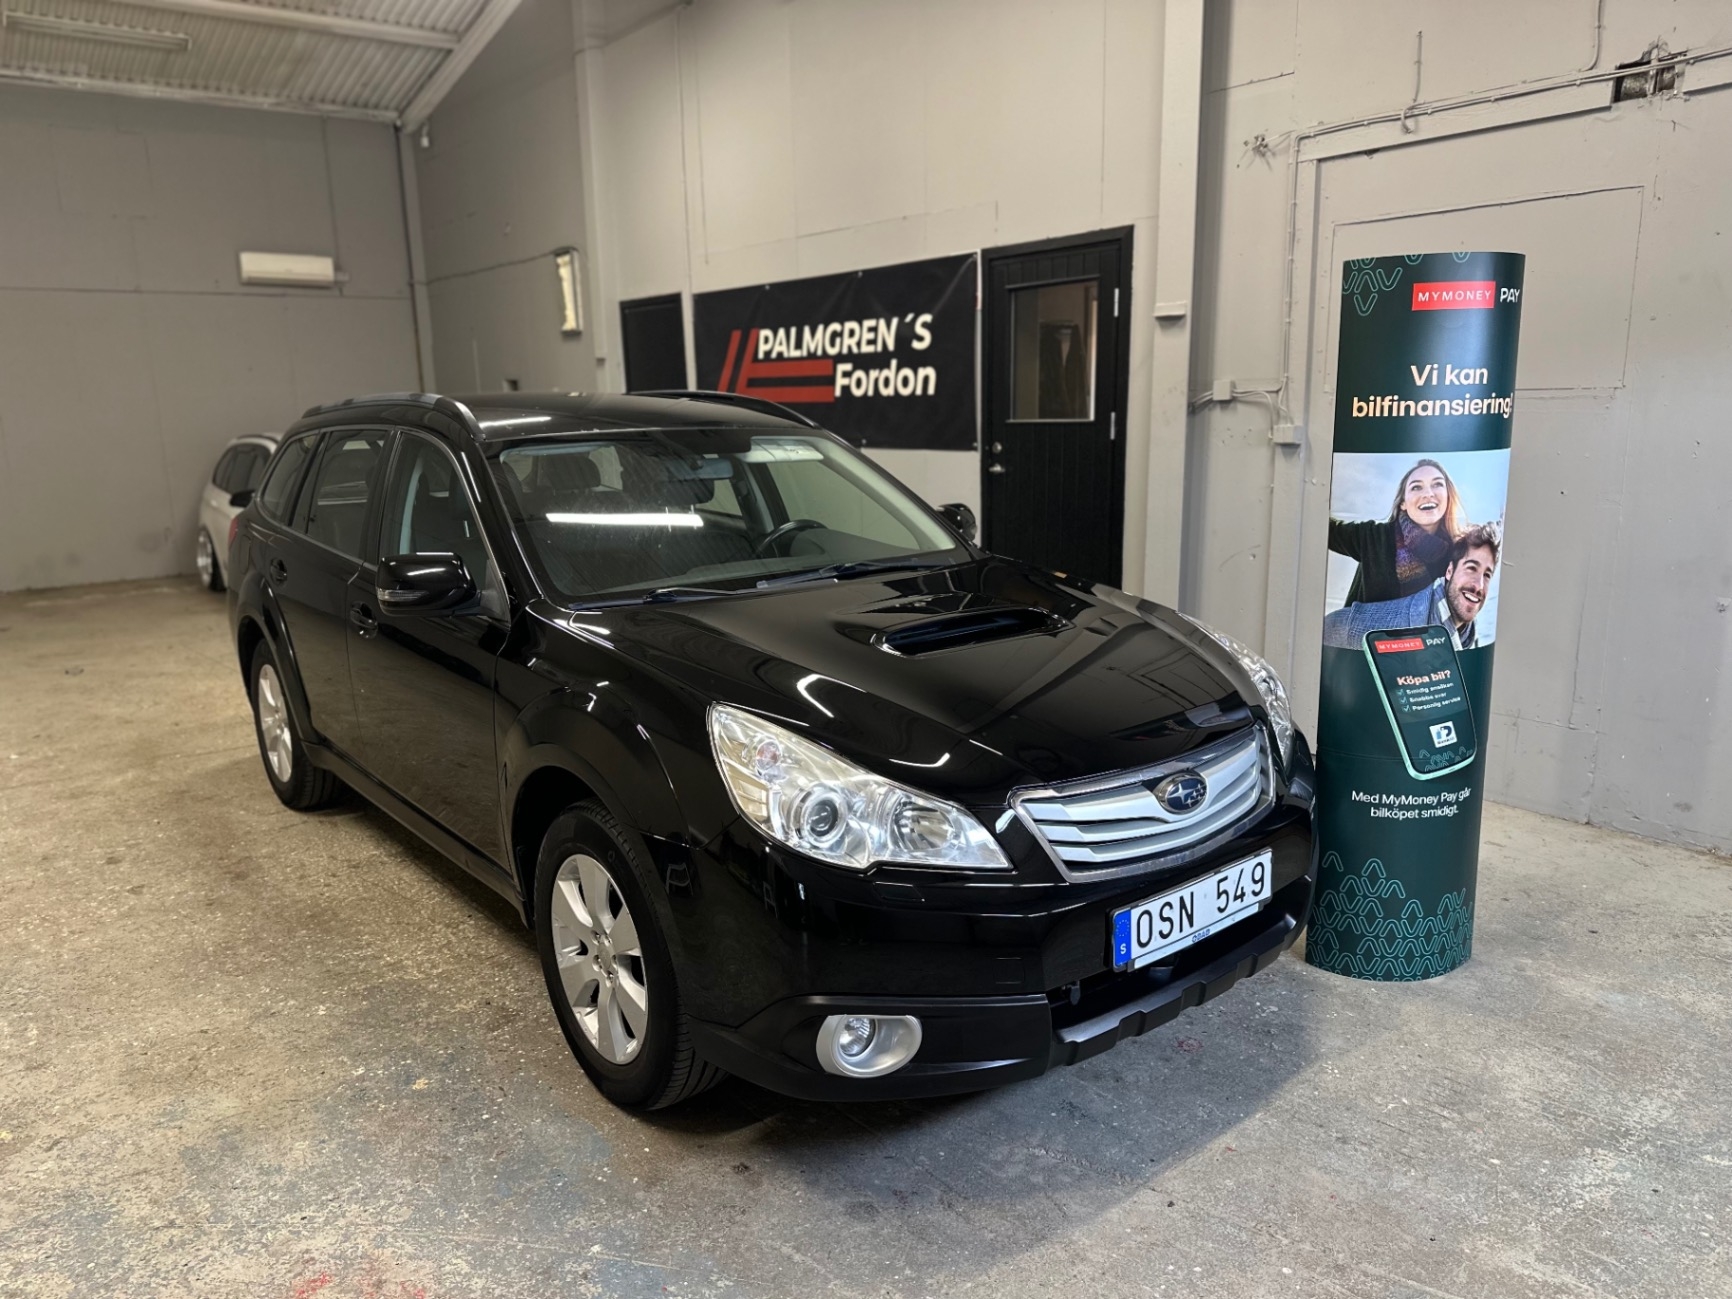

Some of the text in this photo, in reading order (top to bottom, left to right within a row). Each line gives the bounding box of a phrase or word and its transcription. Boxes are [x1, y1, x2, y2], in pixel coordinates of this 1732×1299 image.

[1417, 287, 1520, 303] MYMONEY PAY
[834, 359, 937, 398] Fordon
[1410, 364, 1488, 386] Vi kan
[1352, 392, 1514, 419] bilfinansiering!
[1378, 637, 1445, 650] MYMONEY PAY
[1396, 669, 1451, 686] Köpa bil?
[1351, 787, 1472, 807] Med MyMoney Pay går
[1370, 807, 1419, 821] bilköpet
[1136, 861, 1265, 949] OSN 549
[1119, 943, 1127, 955] S
